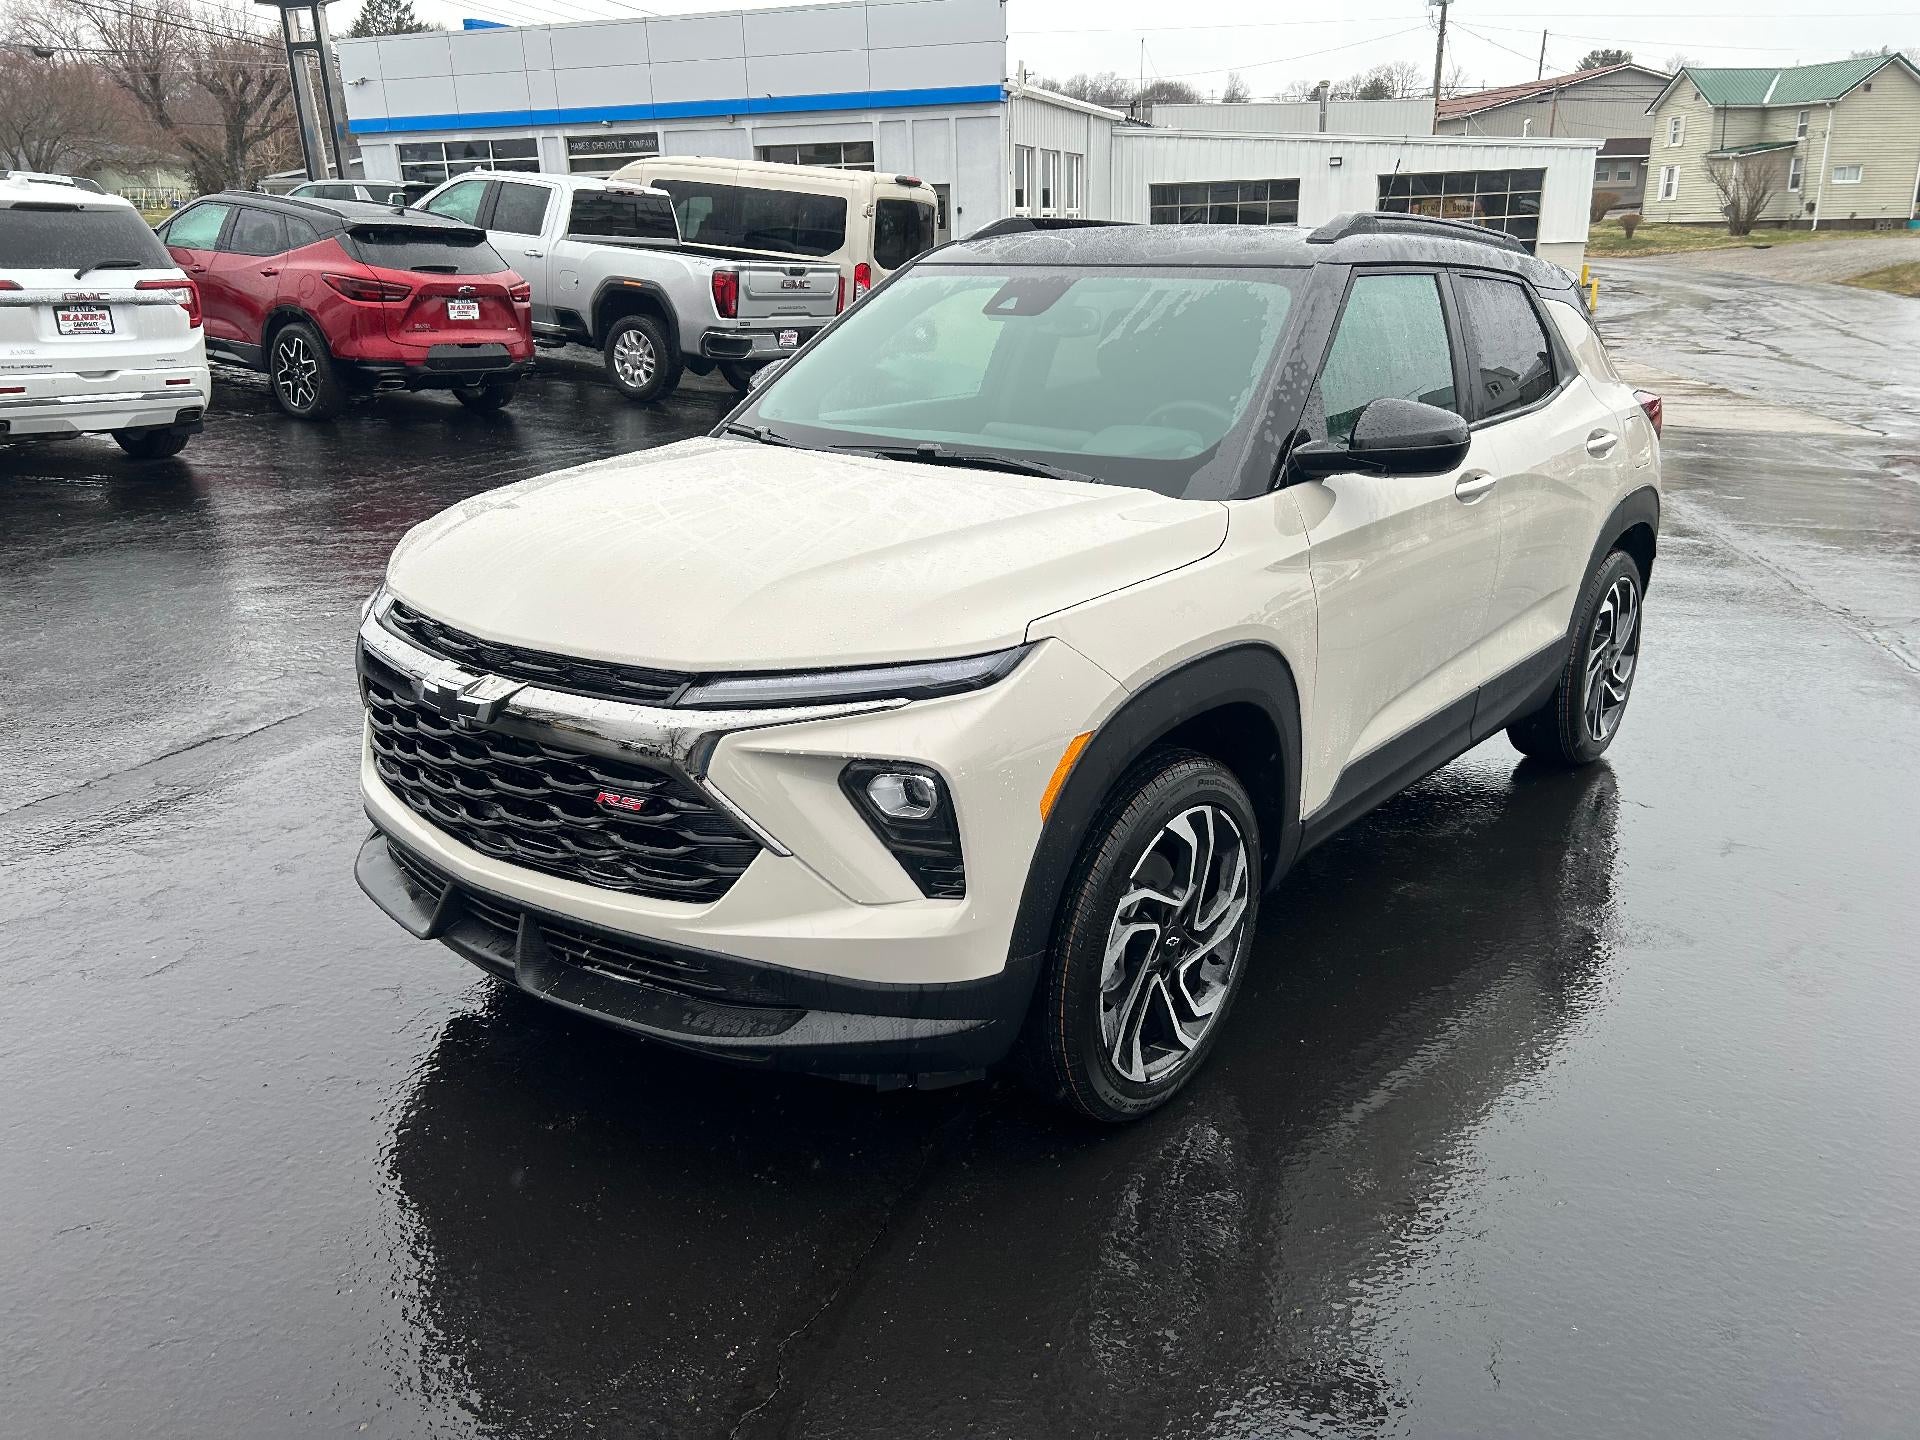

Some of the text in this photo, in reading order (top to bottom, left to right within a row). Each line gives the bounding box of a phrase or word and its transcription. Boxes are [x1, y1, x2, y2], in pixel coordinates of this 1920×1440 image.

[570, 139, 656, 151] HANES CHEVROLET COMPANY
[781, 279, 811, 289] GMC
[64, 292, 110, 301] GMC
[595, 791, 645, 811] RS
